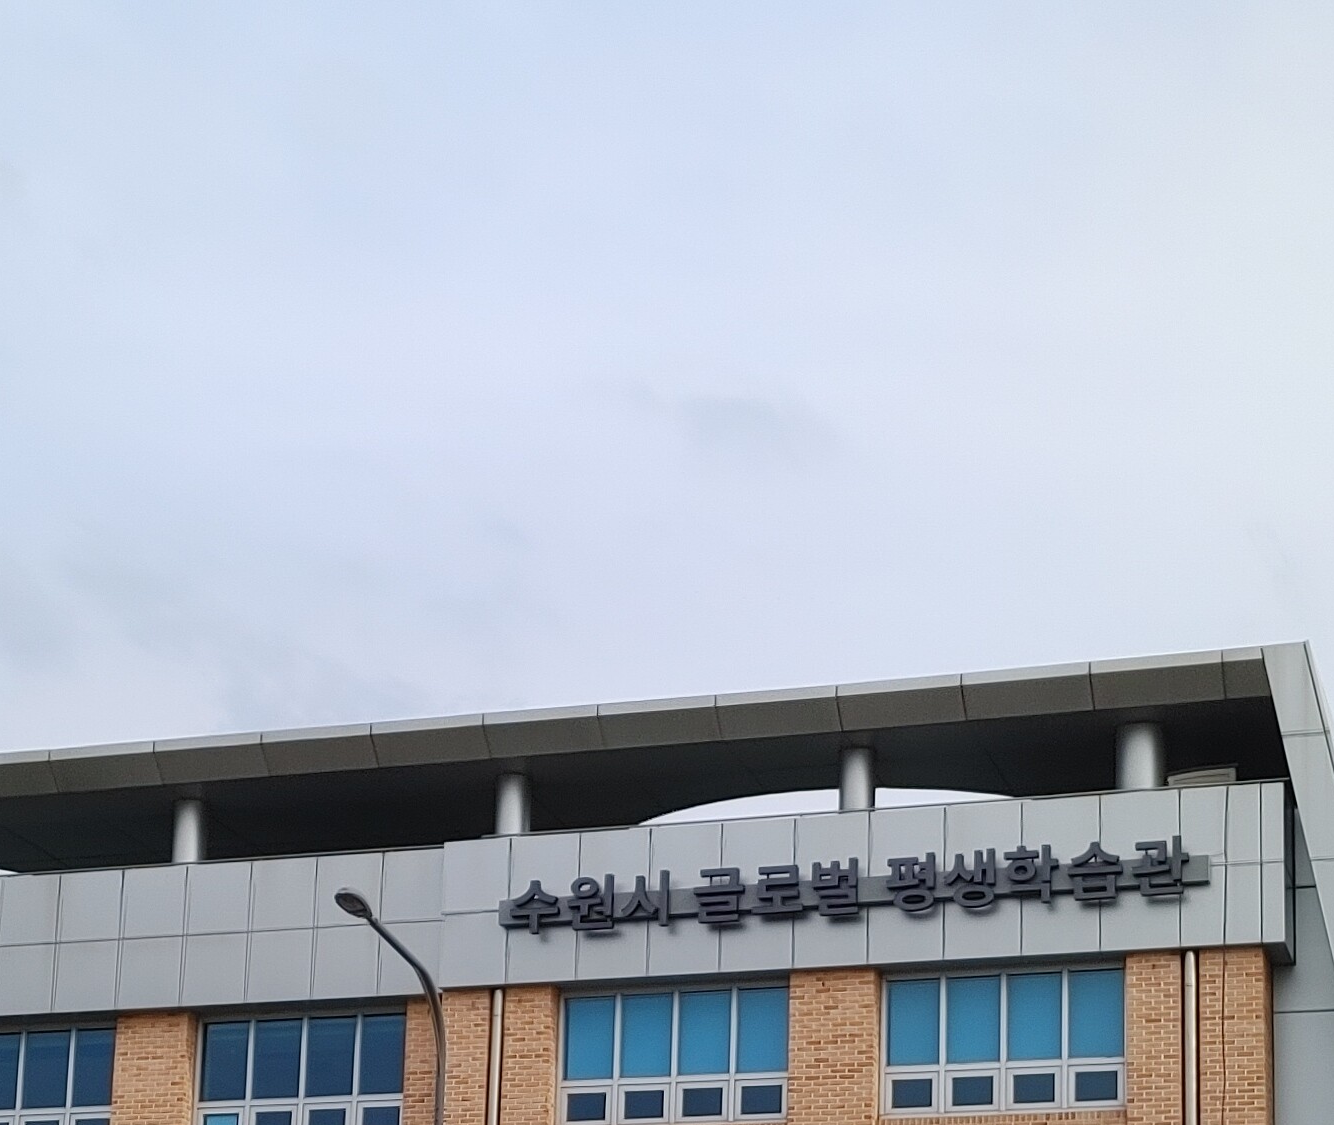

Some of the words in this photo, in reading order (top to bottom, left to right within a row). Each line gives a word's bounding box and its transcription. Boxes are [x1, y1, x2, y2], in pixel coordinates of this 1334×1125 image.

[509, 869, 671, 935] 수원시
[693, 857, 860, 925] 글로벌
[885, 835, 1190, 913] 평생학습관
